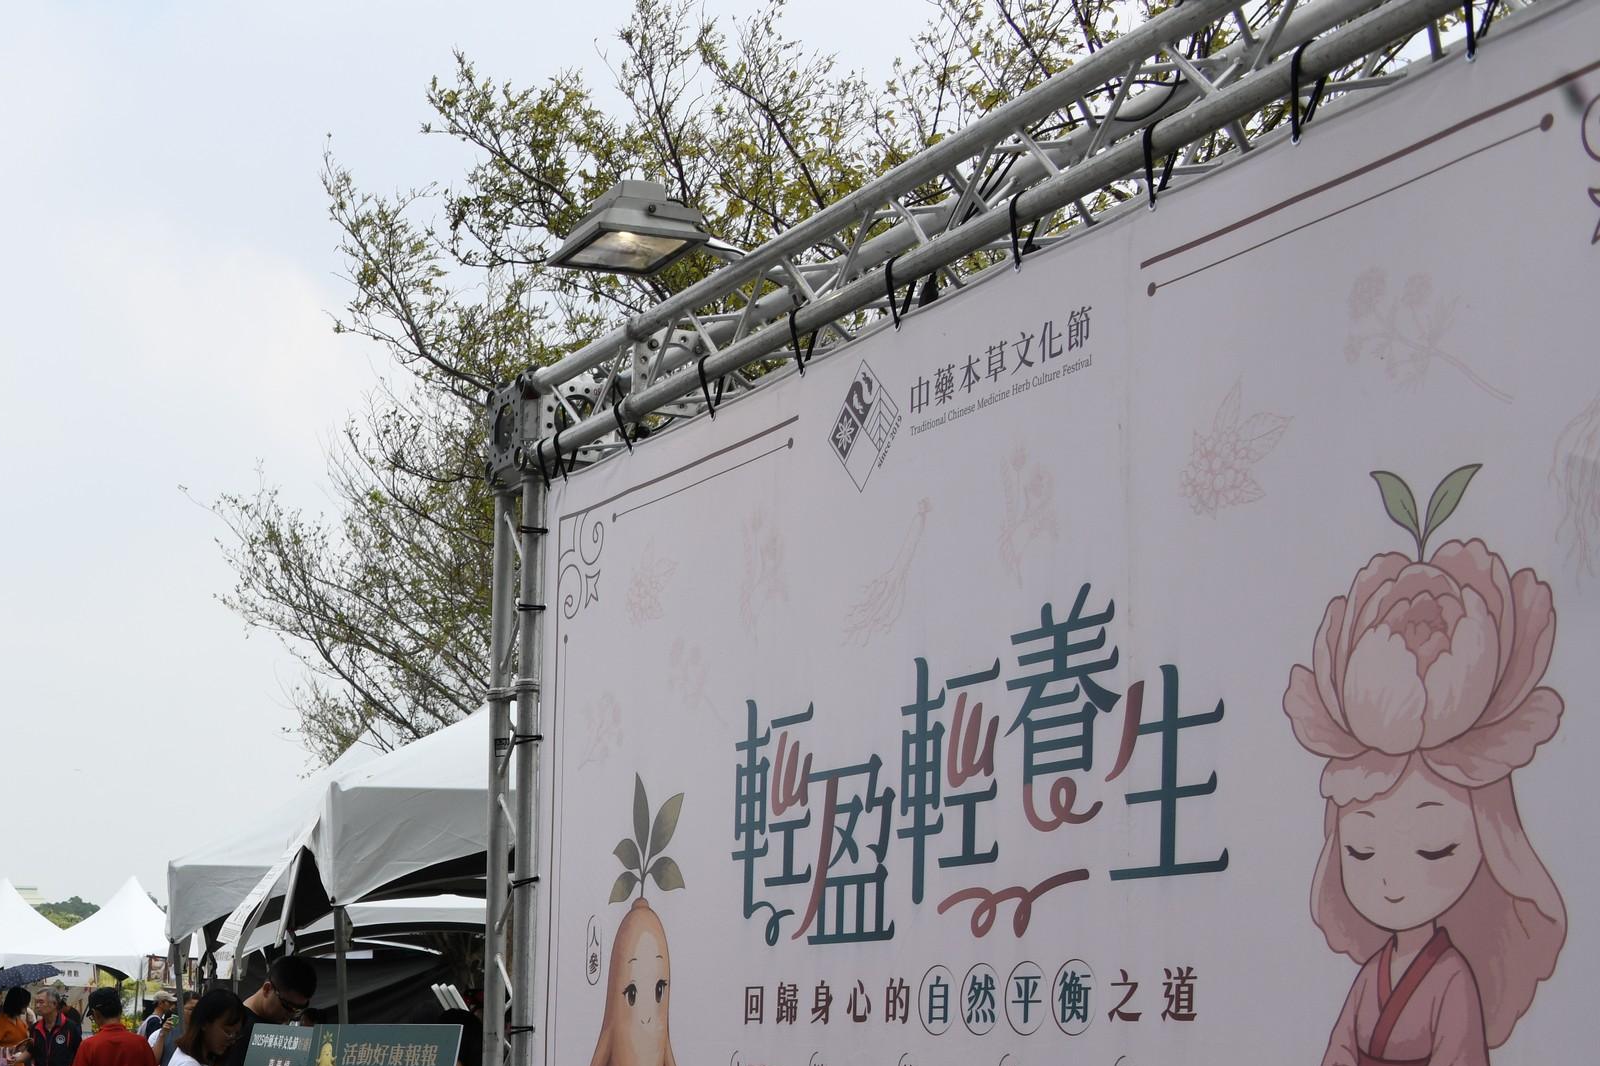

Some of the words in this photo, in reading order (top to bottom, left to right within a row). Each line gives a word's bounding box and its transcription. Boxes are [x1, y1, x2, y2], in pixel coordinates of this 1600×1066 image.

[910, 305, 1093, 415] 中藥本草文化節
[909, 412, 947, 436] Traditional
[947, 402, 976, 422] Chinese
[977, 389, 1011, 411] Medicine
[1011, 378, 1031, 396] Herb
[1031, 369, 1061, 388] Culture
[1061, 354, 1093, 377] Festival
[877, 441, 892, 469] since
[890, 415, 903, 441] 2019
[589, 925, 600, 975] 人參
[743, 965, 1198, 1026] 回歸身心的自然平衡之道
